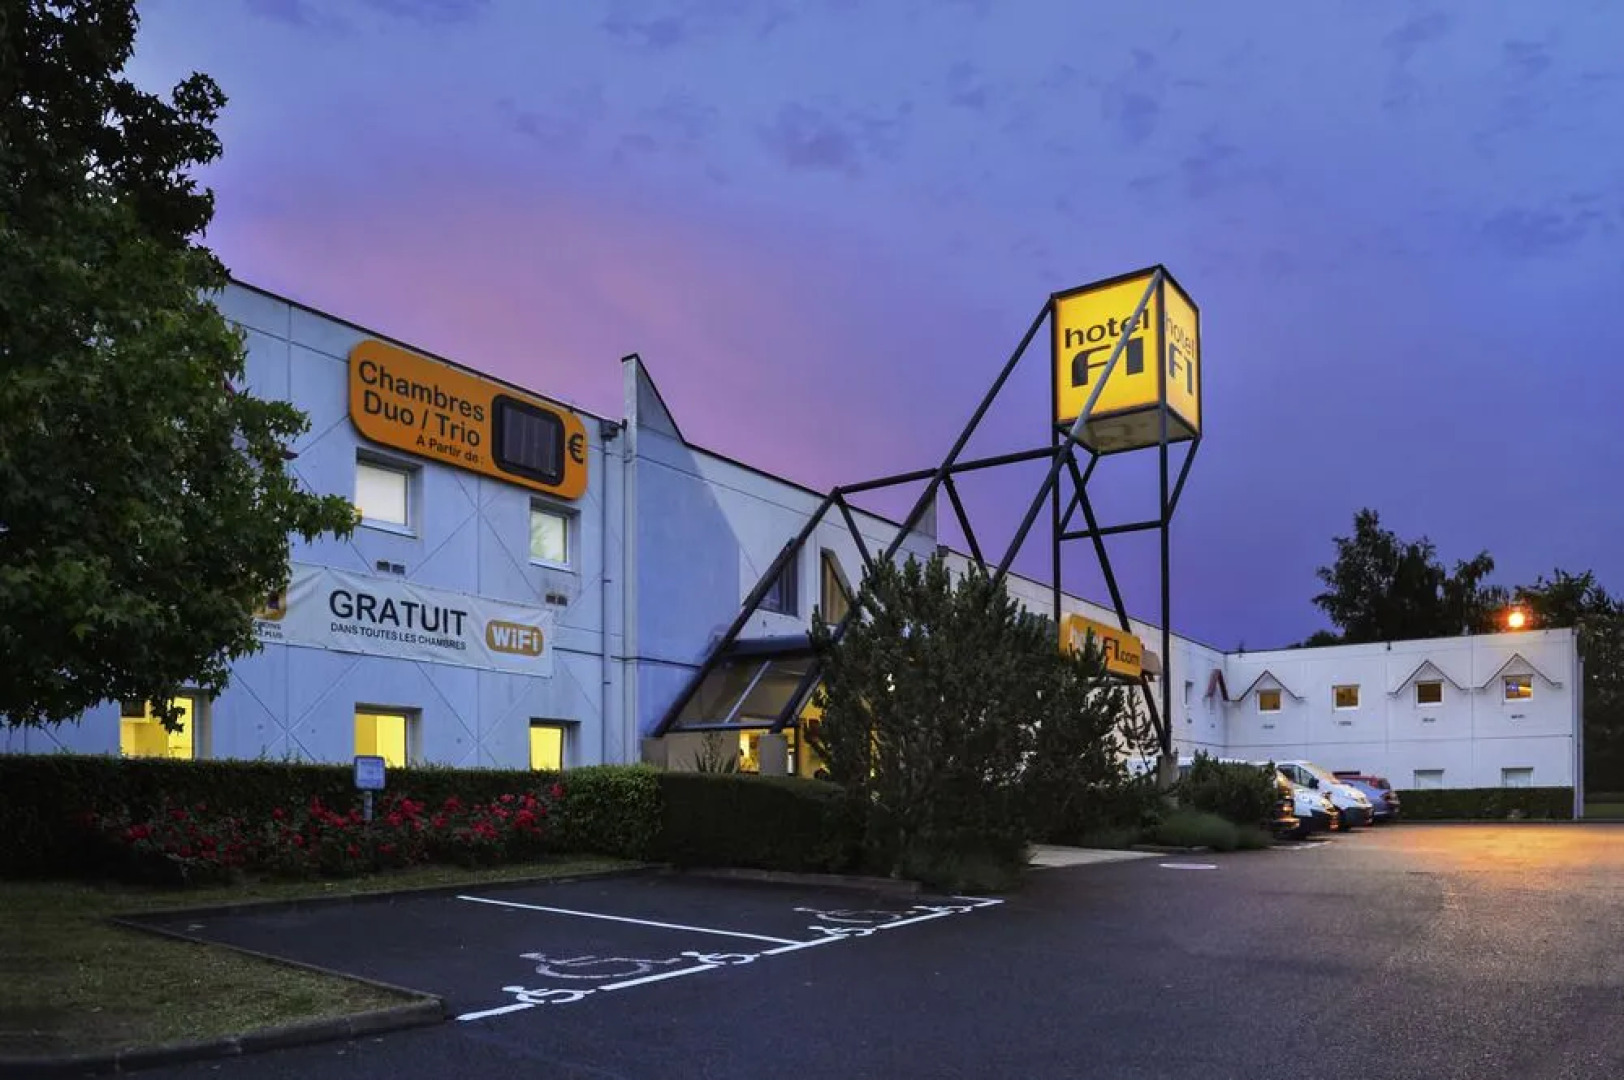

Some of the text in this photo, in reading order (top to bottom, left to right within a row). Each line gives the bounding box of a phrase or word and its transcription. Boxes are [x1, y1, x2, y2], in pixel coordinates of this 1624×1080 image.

[1065, 308, 1149, 349] hotel
[358, 360, 485, 423] Chambres
[363, 389, 415, 426] Duo
[434, 412, 480, 447] Trio
[328, 590, 468, 636] GRATUIT
[330, 622, 467, 650] DANS TOUTES LES CHAMBRES
[491, 627, 540, 655] WiFi
